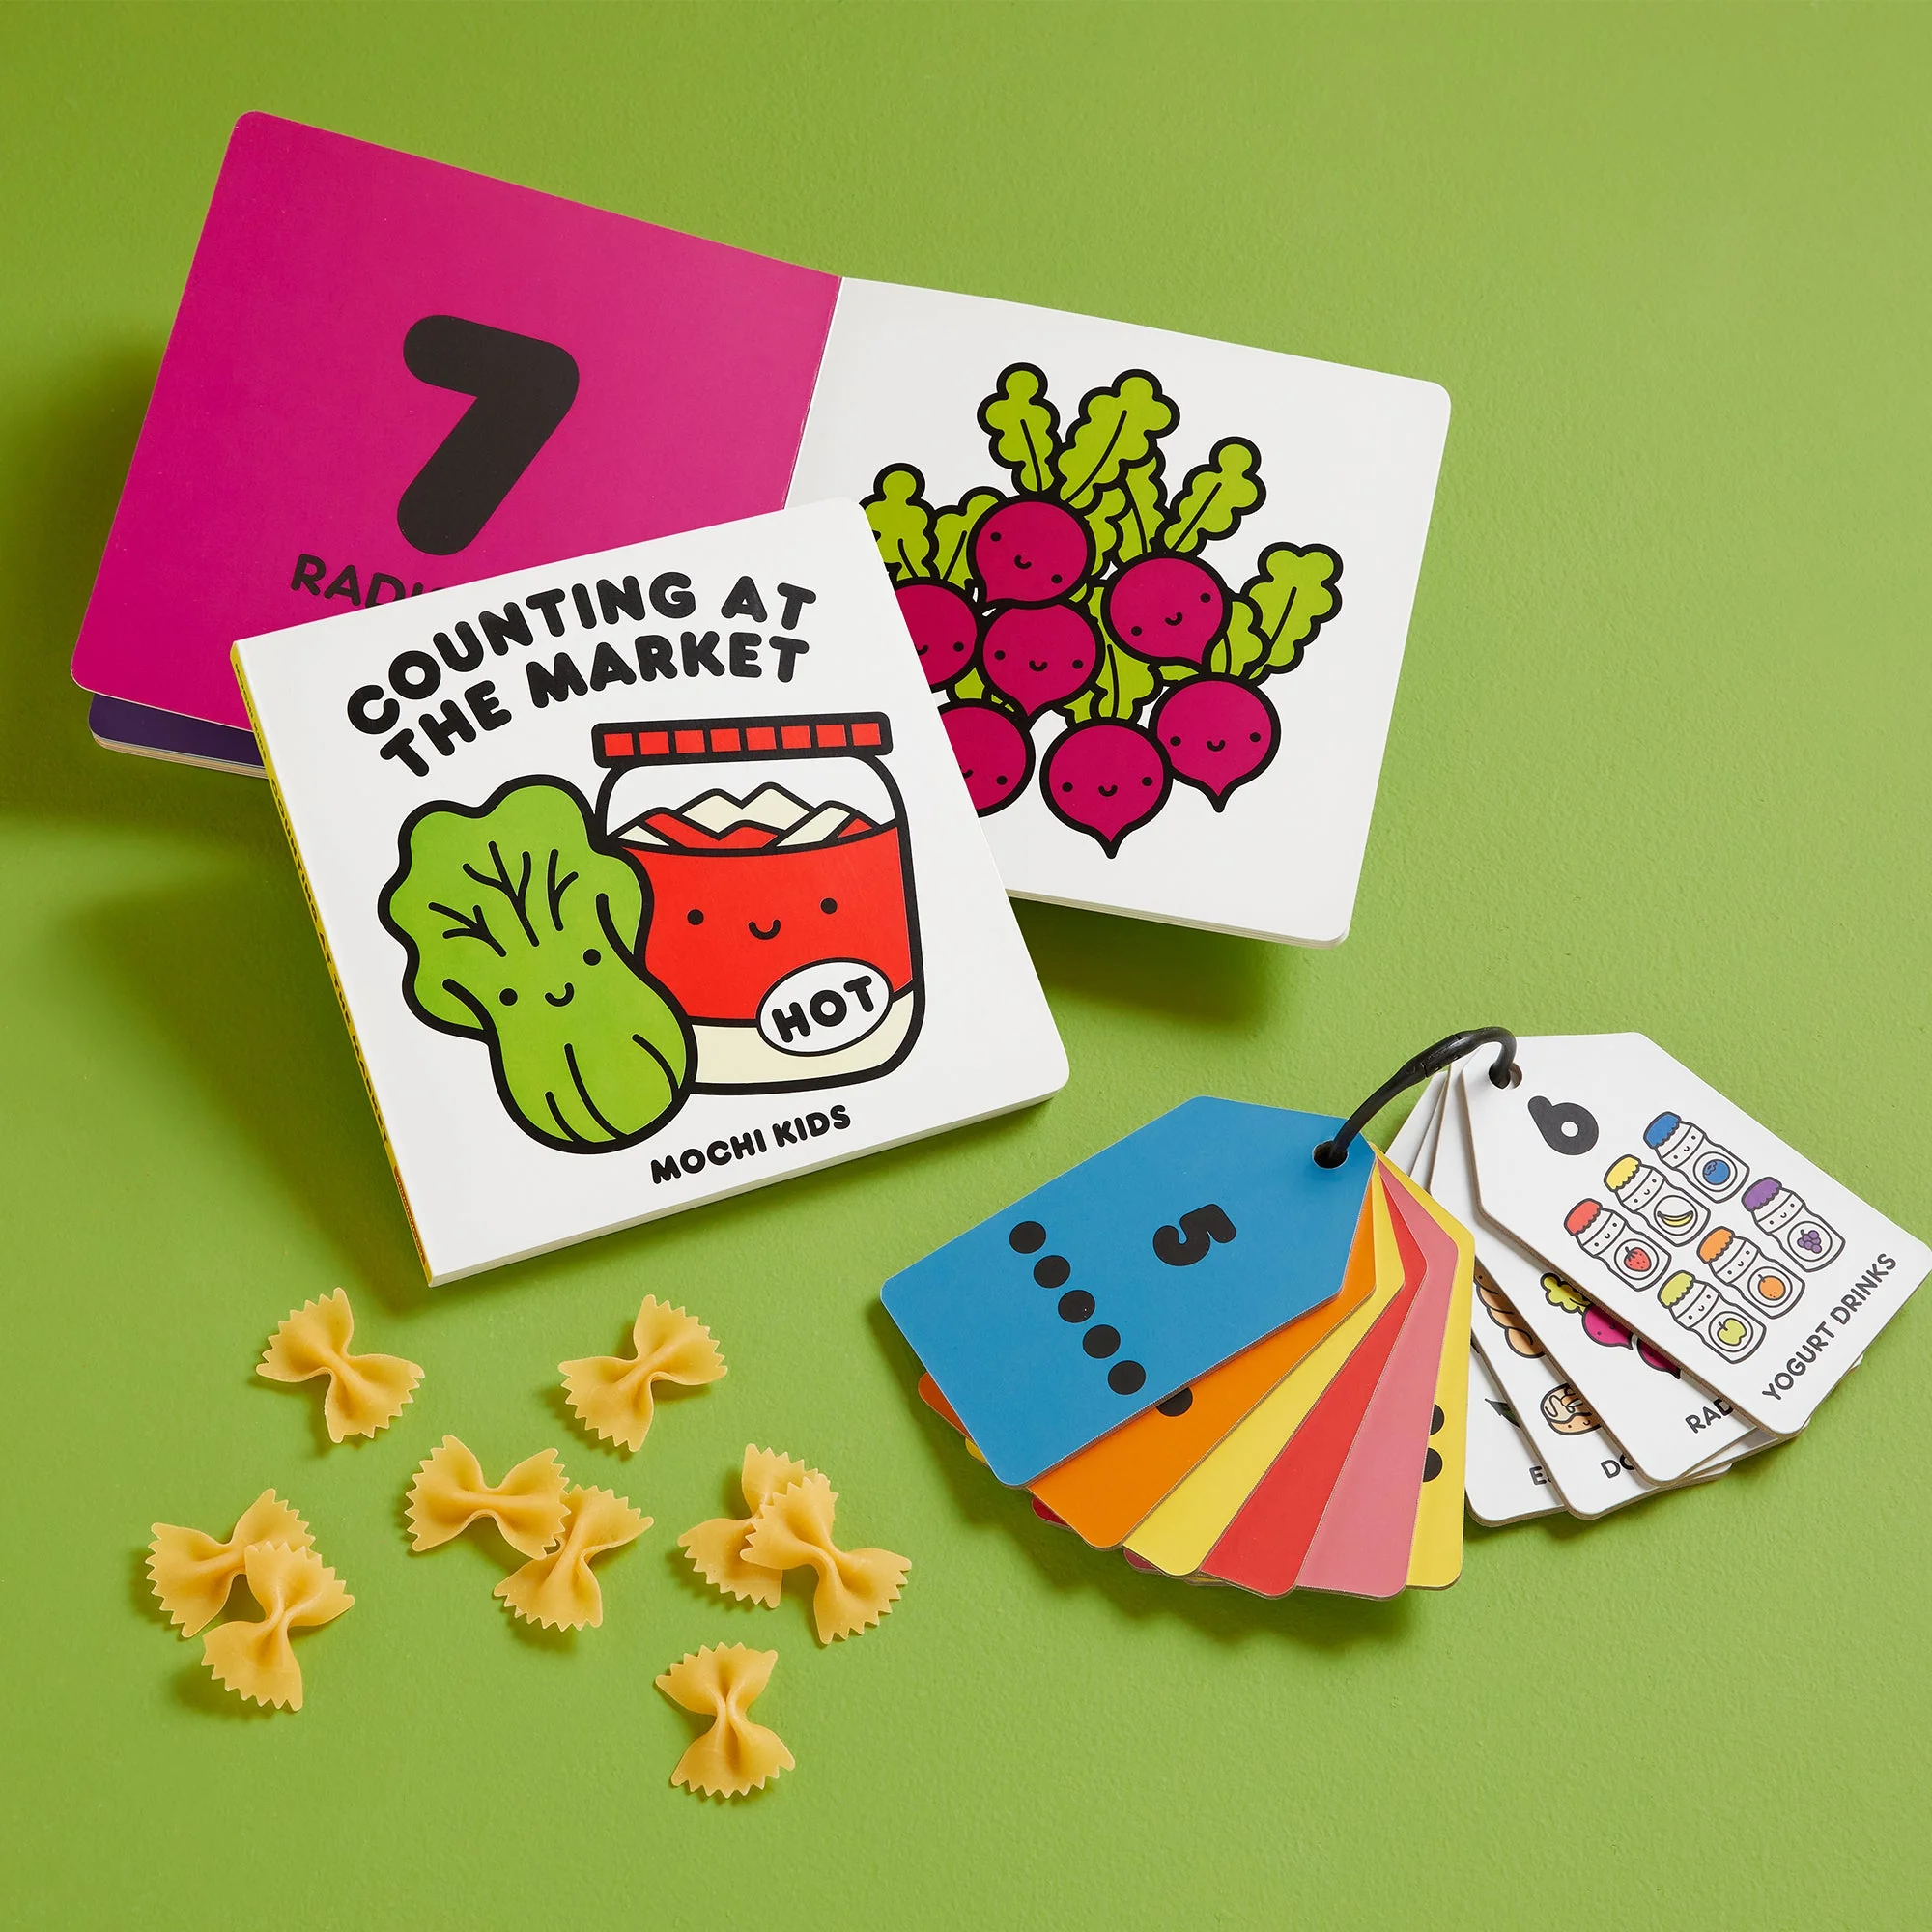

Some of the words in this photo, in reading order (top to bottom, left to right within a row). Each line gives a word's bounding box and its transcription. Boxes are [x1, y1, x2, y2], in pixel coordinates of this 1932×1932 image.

[397, 314, 580, 556] 7
[347, 571, 696, 735] COUNTING
[721, 575, 817, 631] AT
[379, 680, 512, 778] THE
[526, 630, 810, 709] MARKET
[271, 778, 318, 923] COUNTING
[319, 932, 332, 965] AT
[333, 972, 351, 1027] THE
[352, 1034, 389, 1144] MARKET
[771, 975, 875, 1043] HOT
[650, 1128, 768, 1185] MOCHI
[771, 1104, 851, 1148] KIDS
[1527, 1095, 1600, 1156] 6
[1152, 1203, 1237, 1267] 5
[1761, 1321, 1835, 1402] YOGURT
[1830, 1253, 1896, 1325] DRINKS
